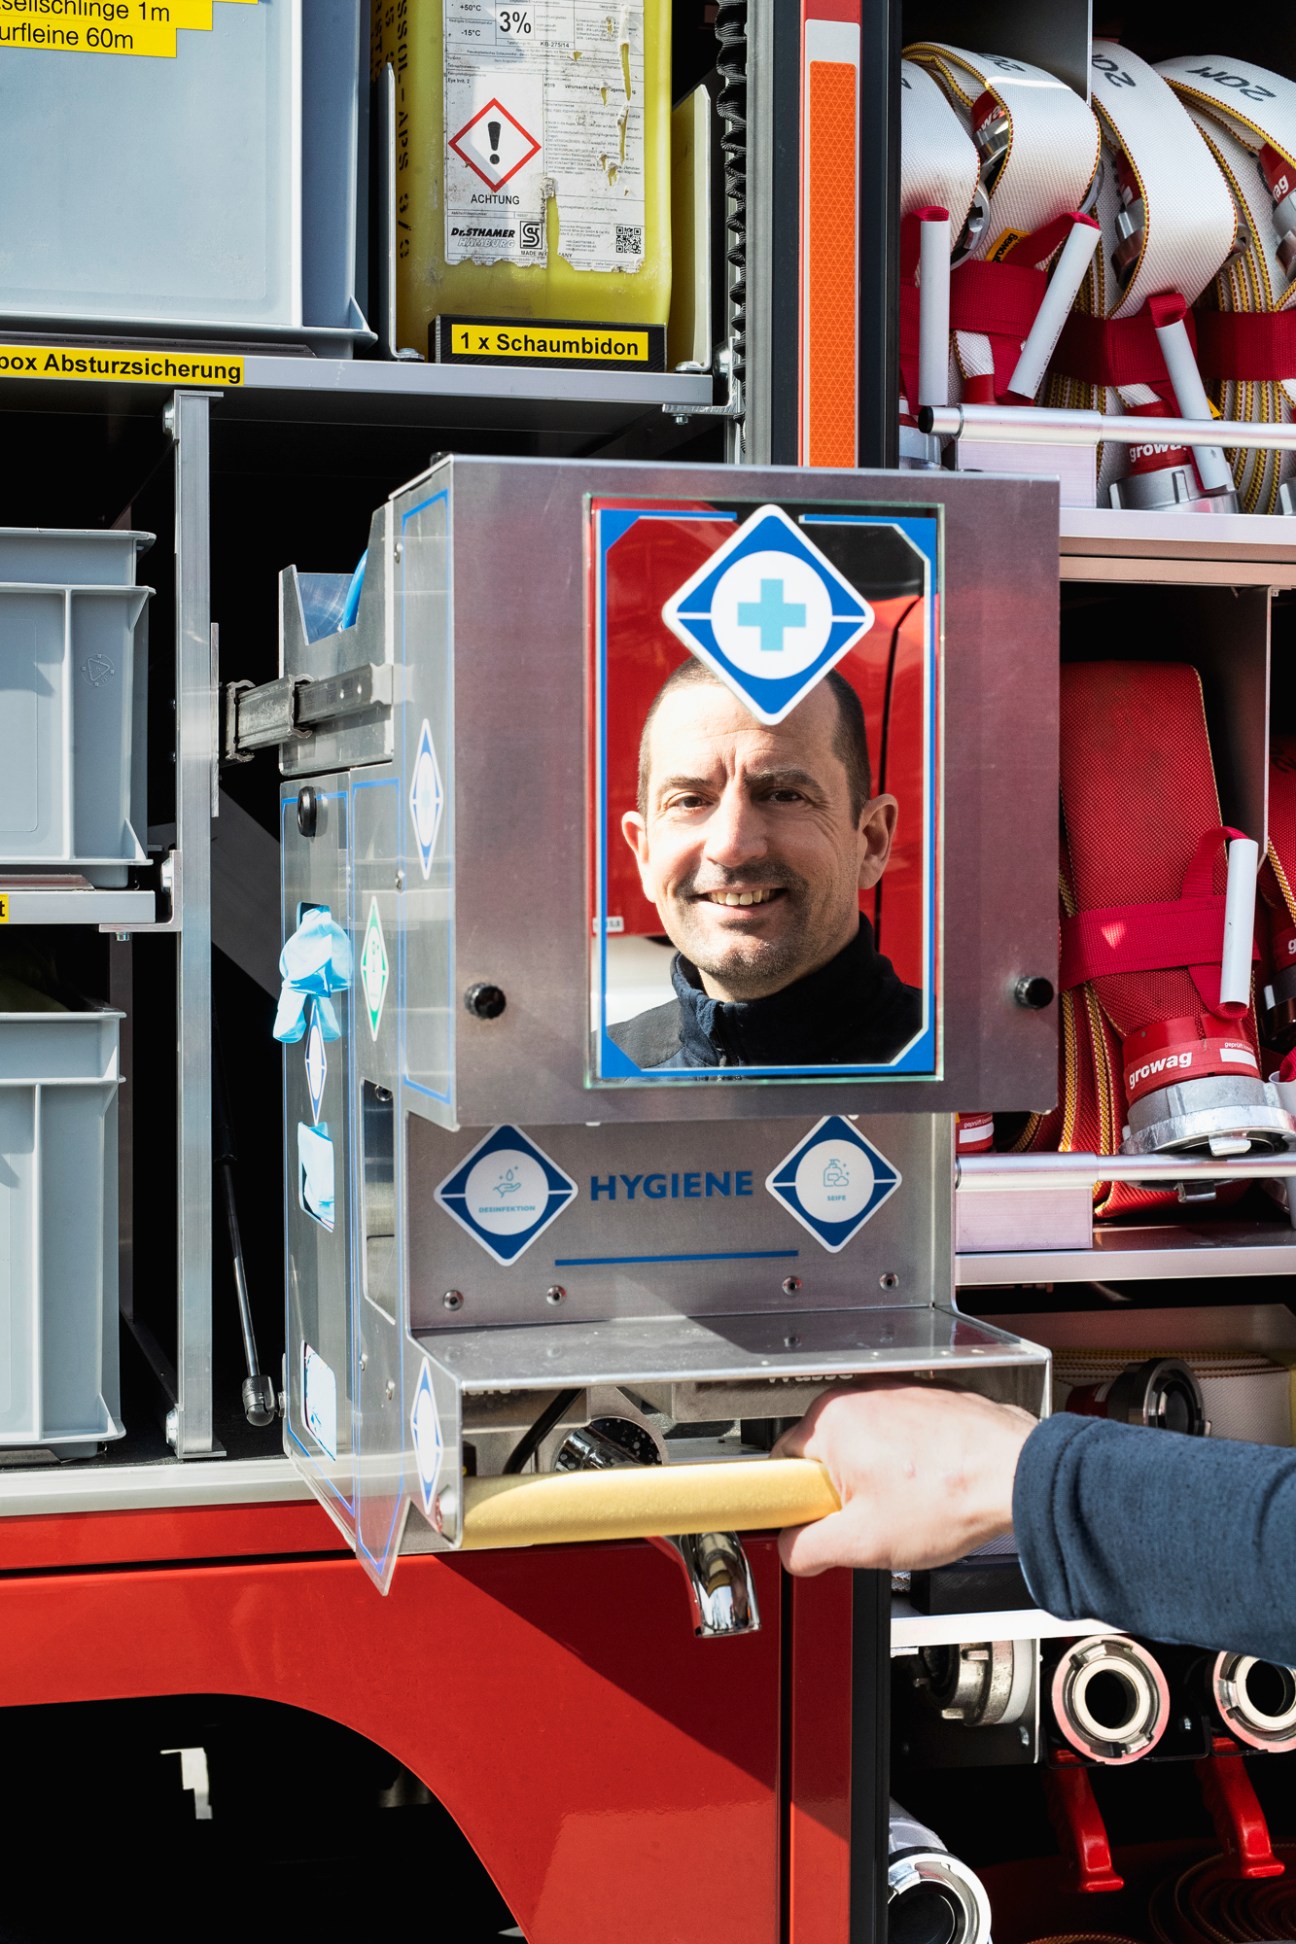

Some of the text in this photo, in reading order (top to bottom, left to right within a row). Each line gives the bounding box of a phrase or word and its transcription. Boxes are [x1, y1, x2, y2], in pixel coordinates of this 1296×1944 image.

[138, 3, 170, 22] 1m
[460, 4, 482, 12] +50°C
[499, 11, 532, 34] 3%
[86, 28, 134, 49] 60m
[461, 29, 481, 37] -15°C
[470, 194, 520, 205] ACHTUNG
[457, 237, 516, 248] HAMBURG
[460, 332, 639, 356] 1 x Schaumbidon
[44, 353, 241, 384] Absturzsicherung
[1129, 1052, 1193, 1090] growag
[590, 1170, 754, 1201] HYGIENE
[478, 1205, 536, 1213] DESINFEKTION
